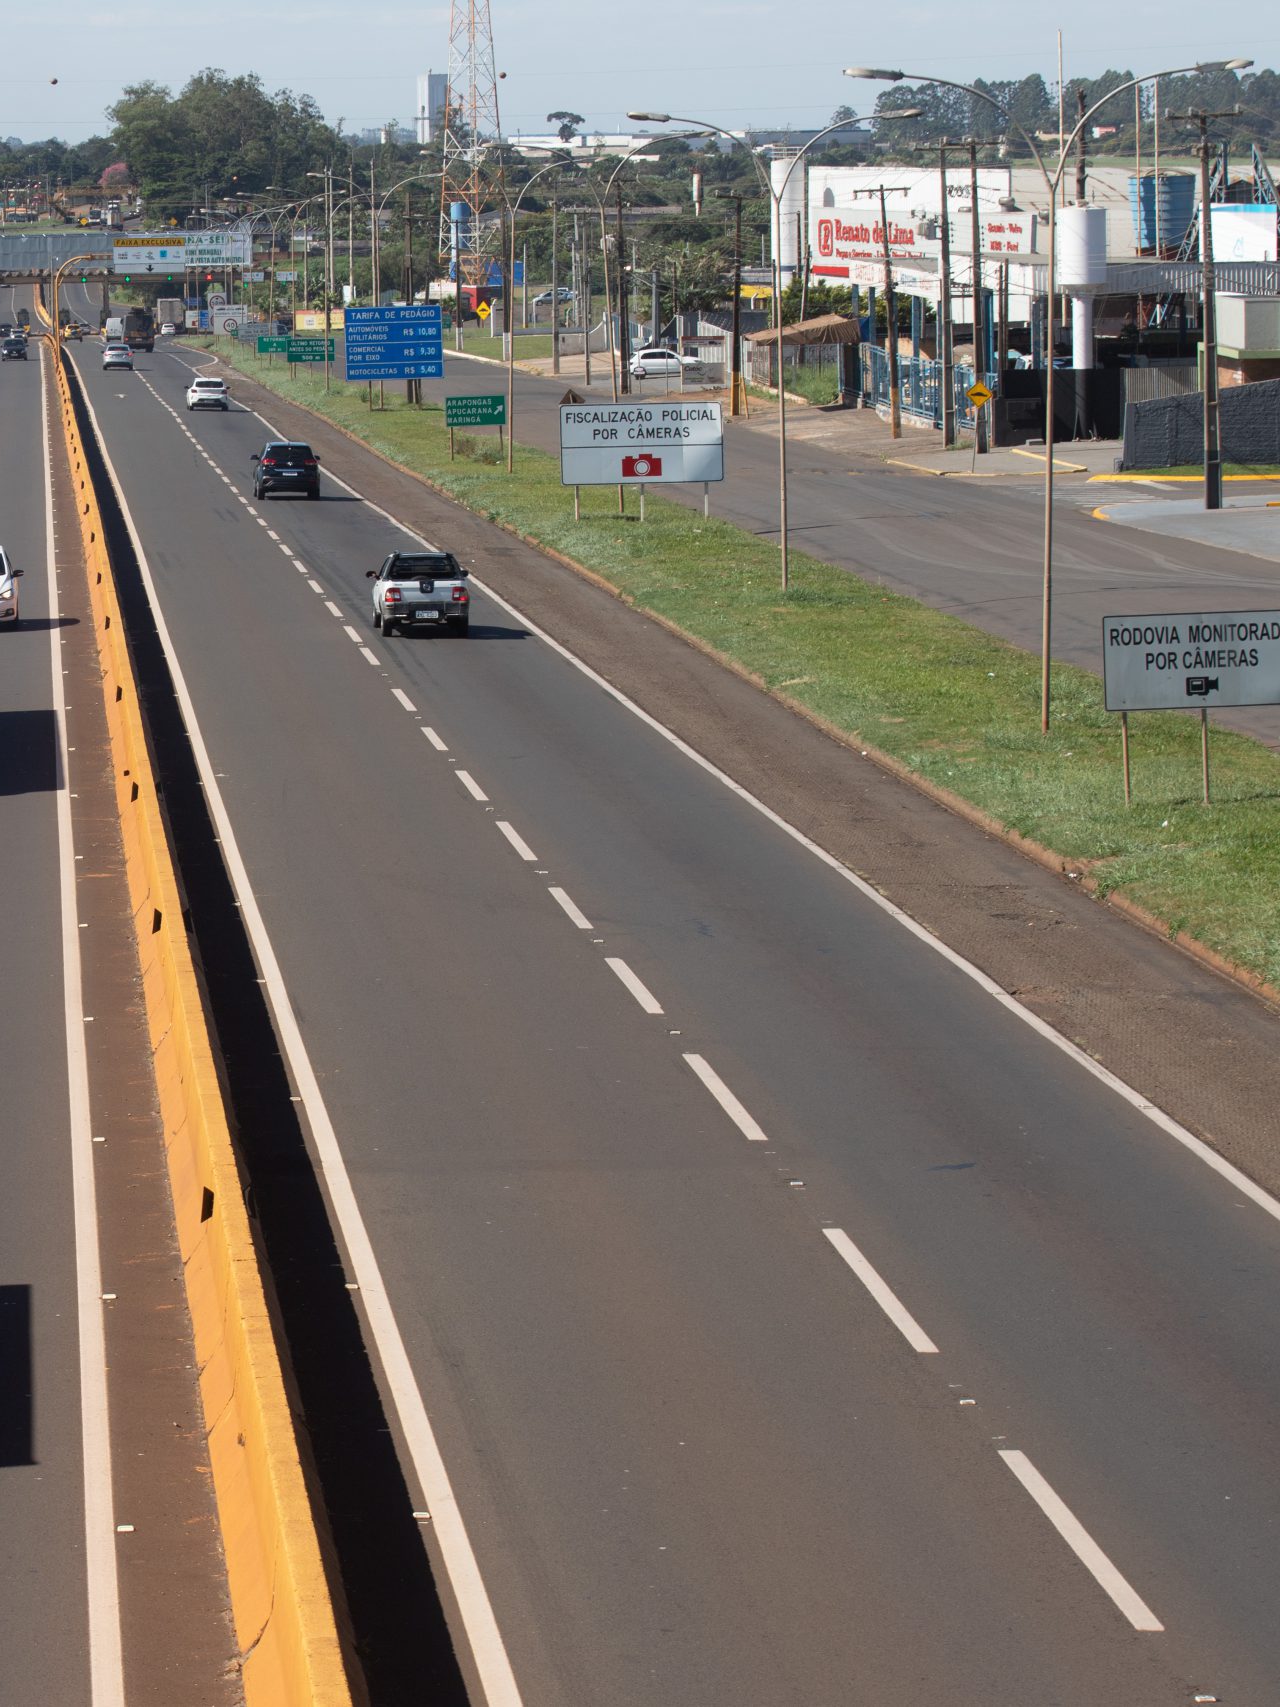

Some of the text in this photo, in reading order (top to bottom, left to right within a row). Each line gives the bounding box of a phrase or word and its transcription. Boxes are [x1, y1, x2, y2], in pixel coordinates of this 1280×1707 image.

[834, 219, 915, 245] Renato de Lima
[351, 312, 380, 320] TARIFA
[385, 311, 395, 319] DE
[400, 308, 435, 318] PEDÁGIO
[348, 325, 389, 333] AUTOMÓVEIS
[403, 327, 437, 336] R$ 10,80
[348, 333, 388, 341] UTILITÁRIOS
[349, 346, 386, 354] COMERCIAL
[404, 347, 436, 357] R$ 9,30
[349, 354, 362, 362] POR
[349, 367, 398, 376] MOTOCICLETAS
[404, 365, 436, 375] R$ 5,40
[447, 398, 492, 407] ARAPONGAS
[447, 407, 493, 415] APUCARANA
[565, 408, 717, 424] FISCALIZAÇÃO POLICIAL
[447, 414, 481, 424] MARINGÁ
[592, 424, 690, 440] POR CÂMERAS
[1109, 622, 1280, 646] RODOVIA MONITORAD
[1145, 646, 1259, 670] POR CÂMERAS
